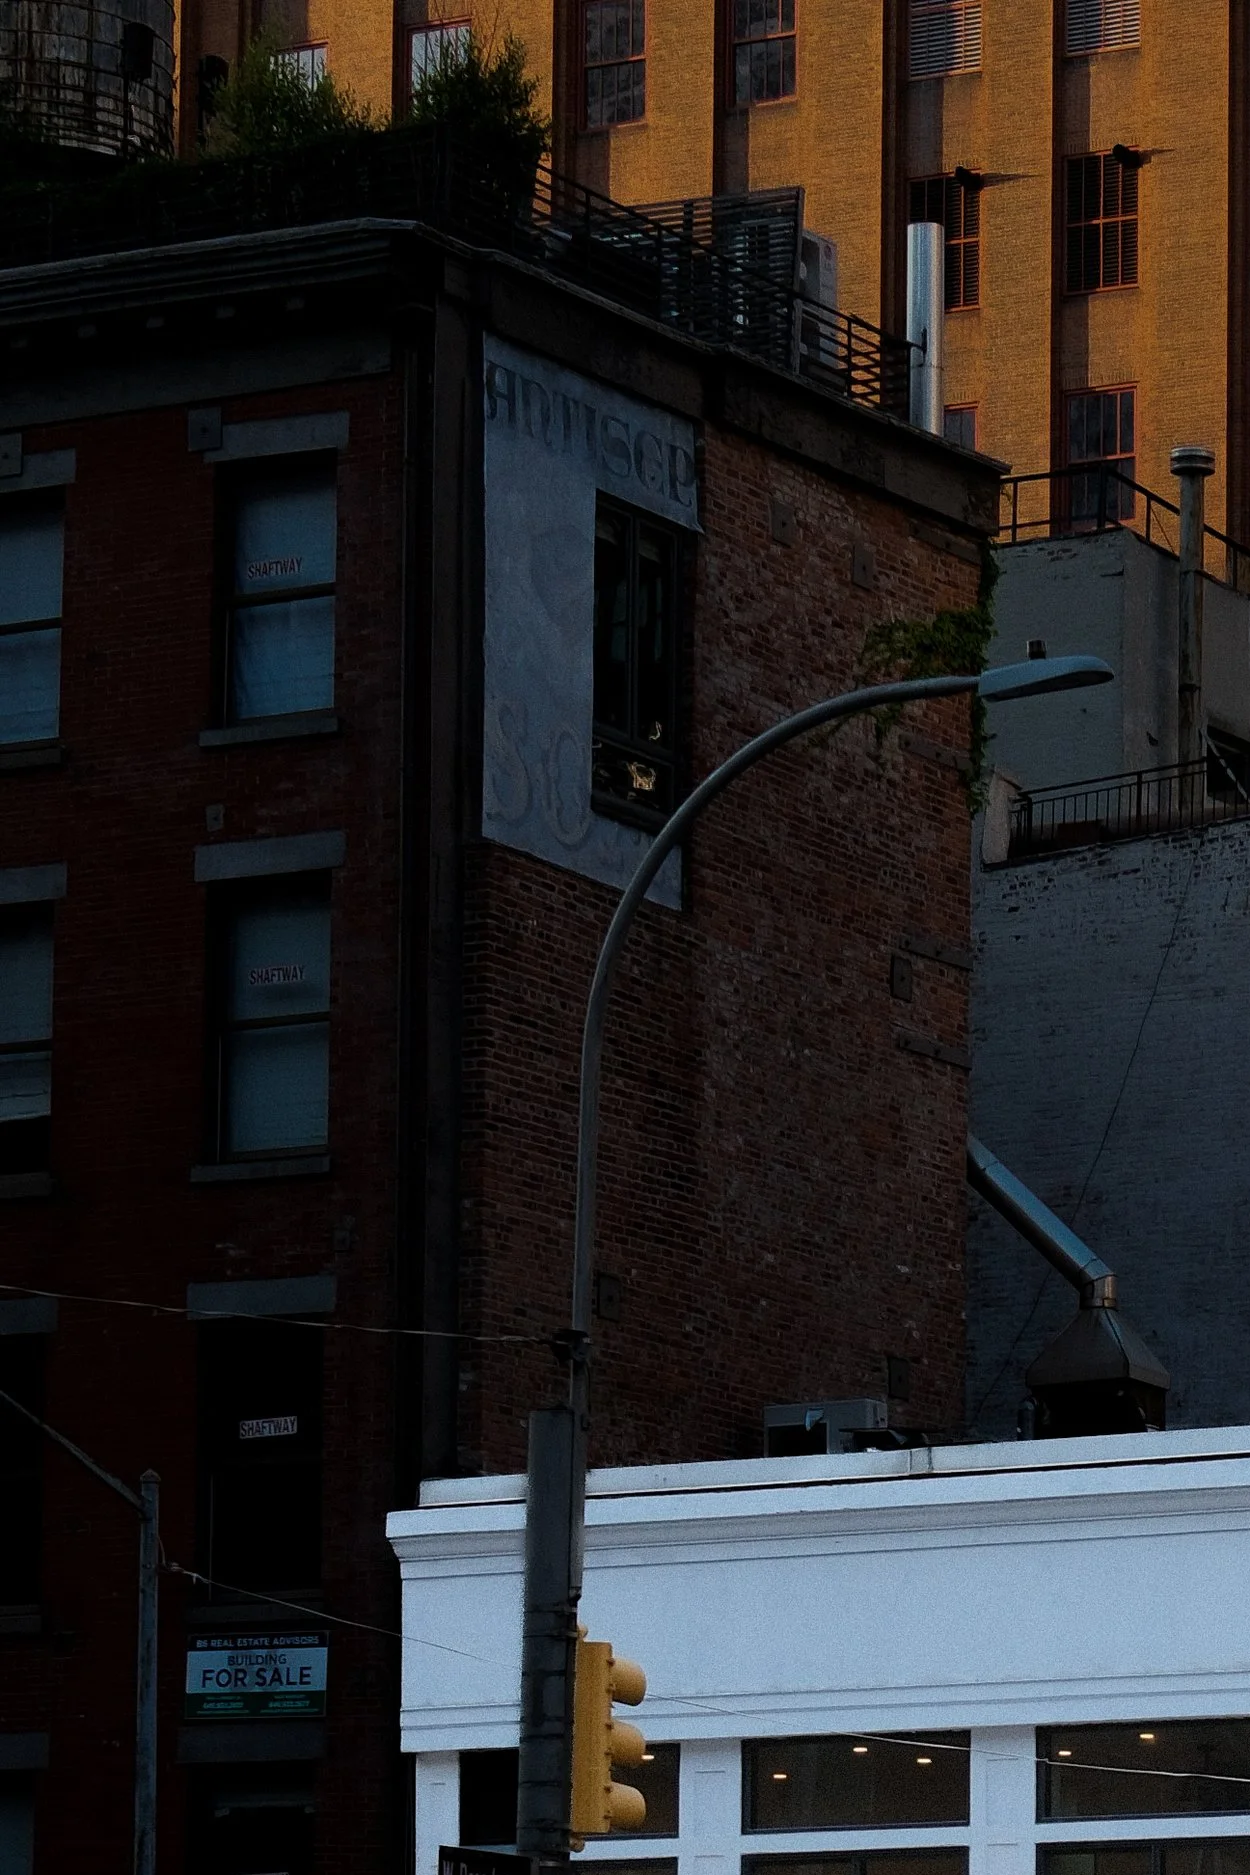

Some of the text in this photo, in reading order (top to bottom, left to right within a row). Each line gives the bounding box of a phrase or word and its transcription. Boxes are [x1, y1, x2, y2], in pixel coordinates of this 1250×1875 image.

[247, 556, 303, 580] SHAFTWAY
[249, 964, 305, 985] SHAFTWAY
[240, 1417, 296, 1438] SHAFTWAY
[211, 1637, 235, 1648] REAL
[237, 1636, 270, 1647] ESTATE
[227, 1653, 287, 1666] BUILDING
[202, 1666, 312, 1688] FOR SALE
